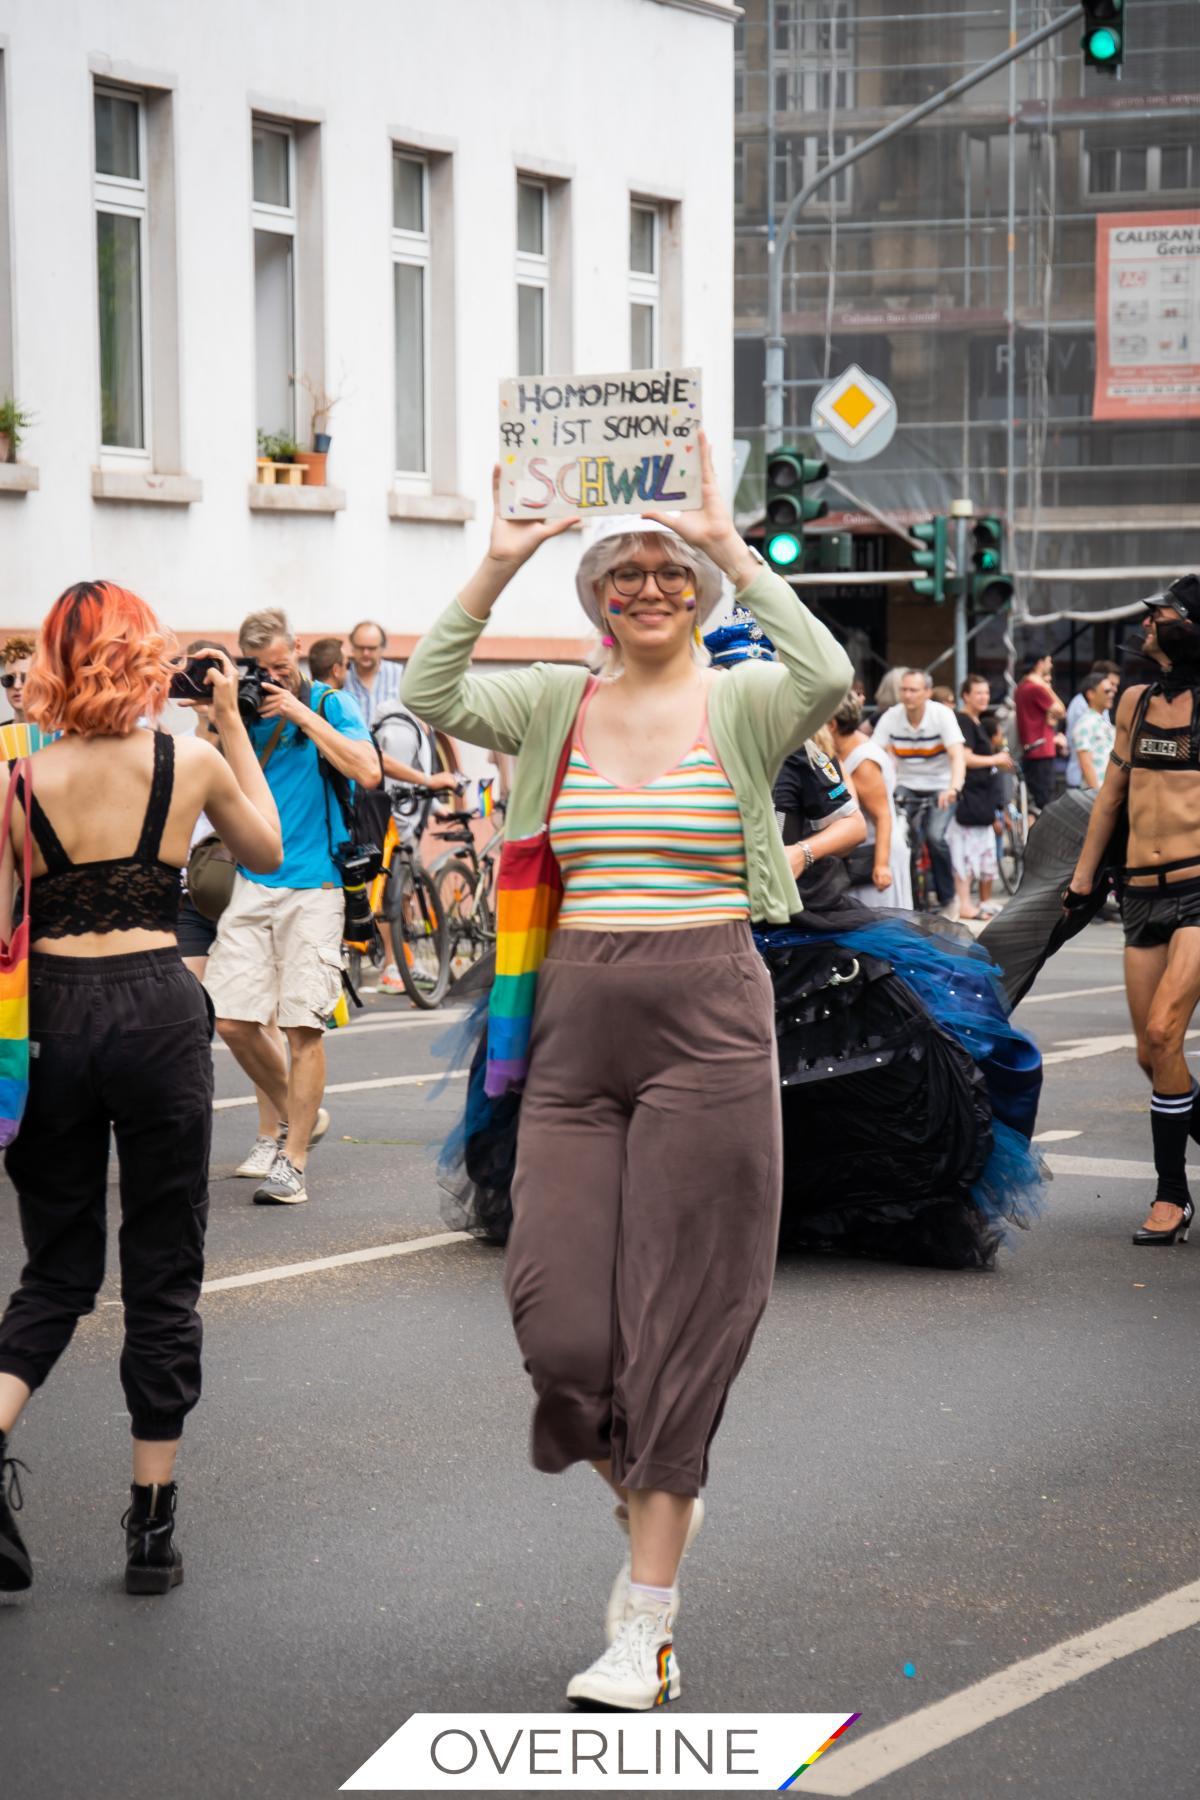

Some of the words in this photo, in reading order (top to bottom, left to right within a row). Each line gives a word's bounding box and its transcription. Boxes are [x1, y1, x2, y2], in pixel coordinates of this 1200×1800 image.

[603, 415, 669, 441] SCHON
[520, 454, 687, 508] SCHWUL
[1140, 740, 1176, 754] POLICE
